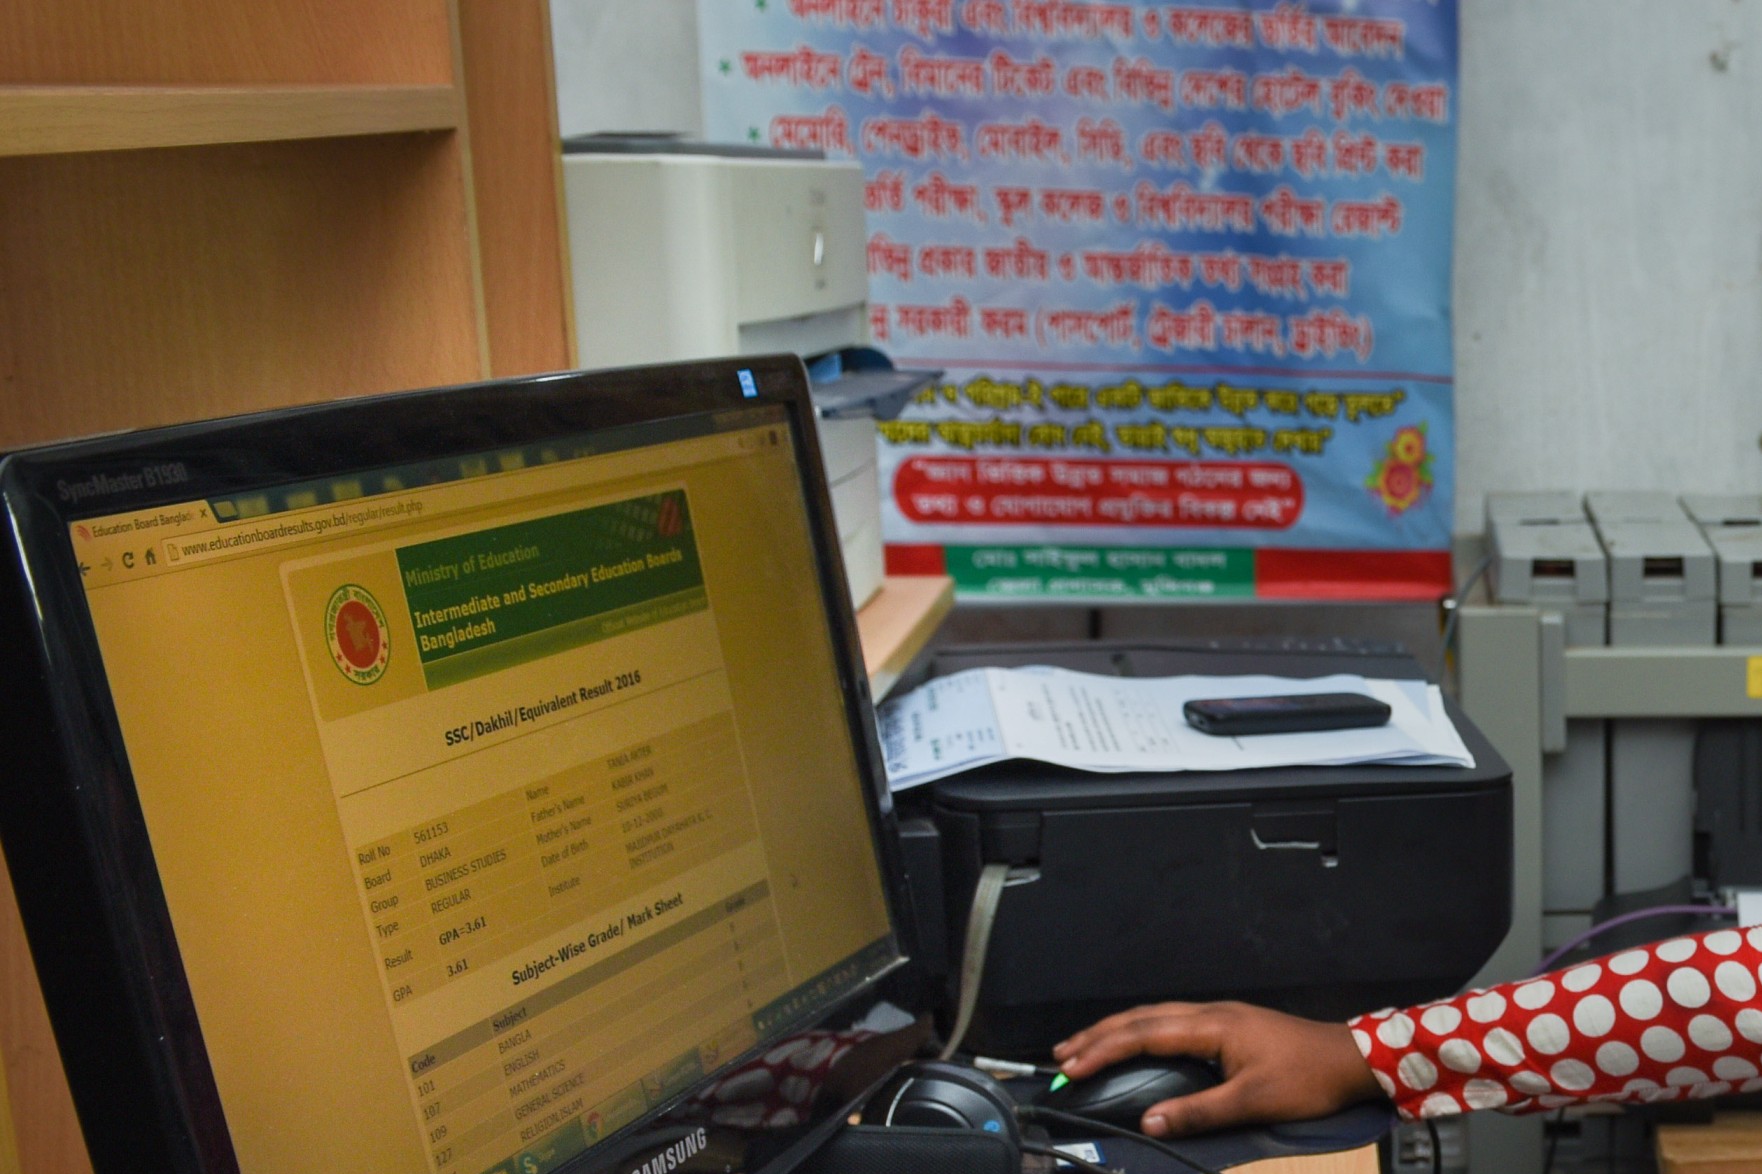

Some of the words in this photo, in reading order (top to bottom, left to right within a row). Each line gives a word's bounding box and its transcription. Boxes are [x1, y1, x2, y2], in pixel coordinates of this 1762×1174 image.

[92, 520, 134, 539] Education
[134, 516, 159, 533] Board
[405, 562, 461, 588] Ministry
[463, 557, 476, 574] of
[479, 544, 540, 570] Education
[414, 594, 500, 628] Intermediate
[502, 586, 527, 606] and
[528, 572, 590, 601] Secondary
[591, 557, 645, 584] Education
[646, 547, 683, 569] Boards
[419, 618, 497, 653] Bangladesh
[444, 691, 579, 747] SSC/Dakhil/Equivalent
[579, 679, 615, 703] Result
[615, 669, 642, 692] 2016
[525, 785, 550, 801] Name
[357, 849, 379, 867] Roll
[379, 844, 392, 859] No
[535, 823, 572, 846] Mother's
[540, 851, 560, 869] Date
[364, 869, 392, 890] Board
[420, 845, 452, 868] DHAKA
[370, 894, 400, 917] Group
[425, 863, 470, 892] BUSINESS
[470, 849, 507, 875] STUDIES
[548, 874, 581, 898] Institute
[376, 919, 400, 940] Type
[430, 888, 472, 915] REGULAR
[511, 939, 587, 986] Subject-Wise
[587, 918, 626, 949] Grade/
[627, 905, 653, 930] Mark
[653, 891, 684, 917] Sheet
[384, 948, 414, 971] Result
[438, 915, 488, 947] GPA=3.61
[392, 984, 414, 1002] GPA
[446, 958, 471, 979] 3.61
[411, 1054, 437, 1074] Code
[492, 1006, 528, 1033] Subject
[417, 1079, 436, 1098] 101
[497, 1028, 533, 1055] BANGLA
[423, 1101, 442, 1121] 107
[503, 1049, 540, 1078] ENGLISH
[429, 1125, 448, 1144] 109
[508, 1058, 566, 1099] MATHEMATICS
[435, 1147, 453, 1167] 127
[514, 1093, 551, 1121] GENERAL
[550, 1072, 586, 1100] SCIENCE
